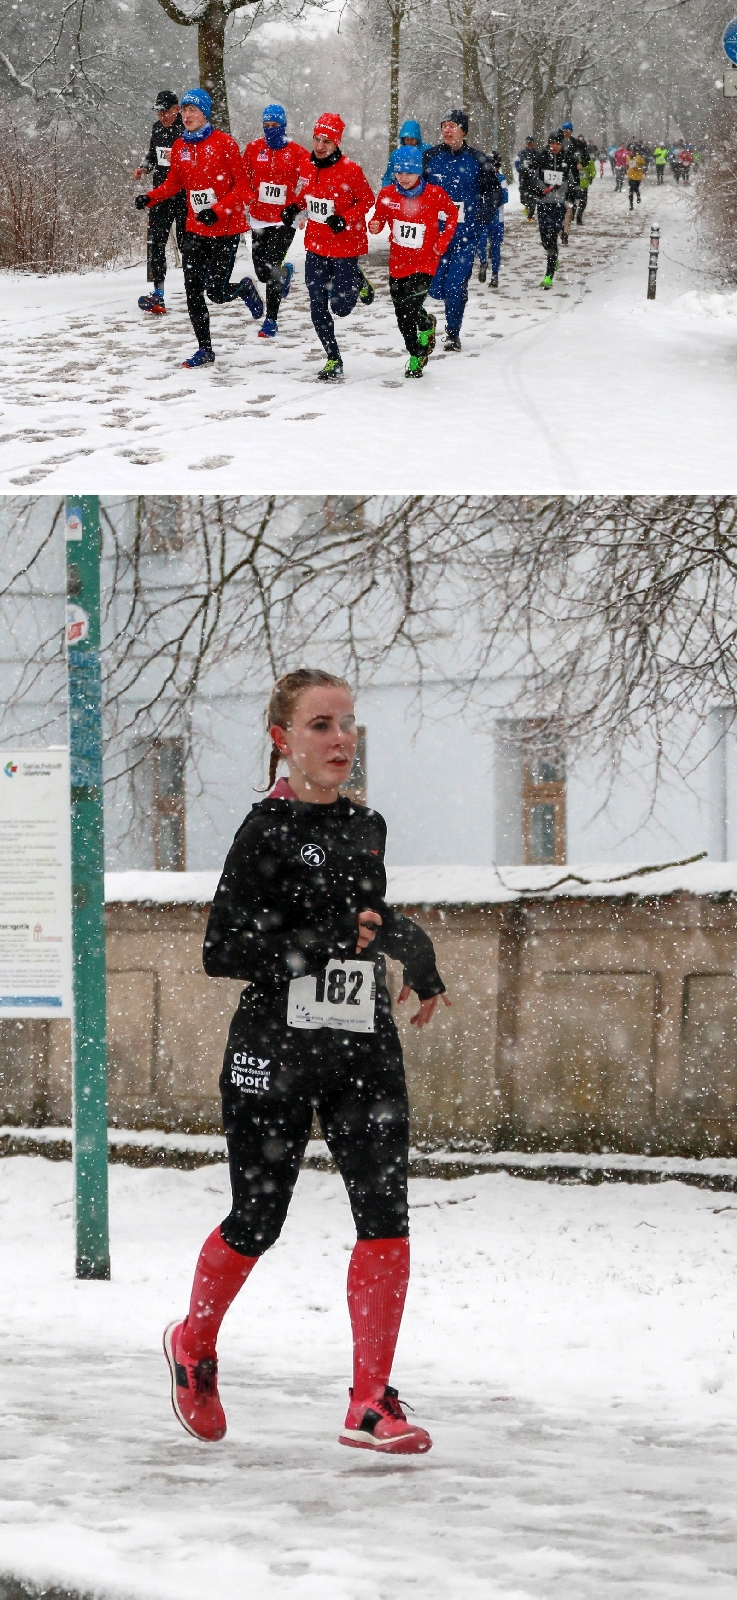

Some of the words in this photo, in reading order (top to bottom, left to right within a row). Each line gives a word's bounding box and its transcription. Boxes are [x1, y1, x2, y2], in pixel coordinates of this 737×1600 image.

[191, 192, 210, 205] 192
[265, 185, 281, 198] 170
[309, 200, 328, 216] 188
[400, 224, 417, 240] 171
[313, 967, 364, 1006] 182
[233, 1052, 271, 1070] City
[230, 1070, 270, 1091] Sport
